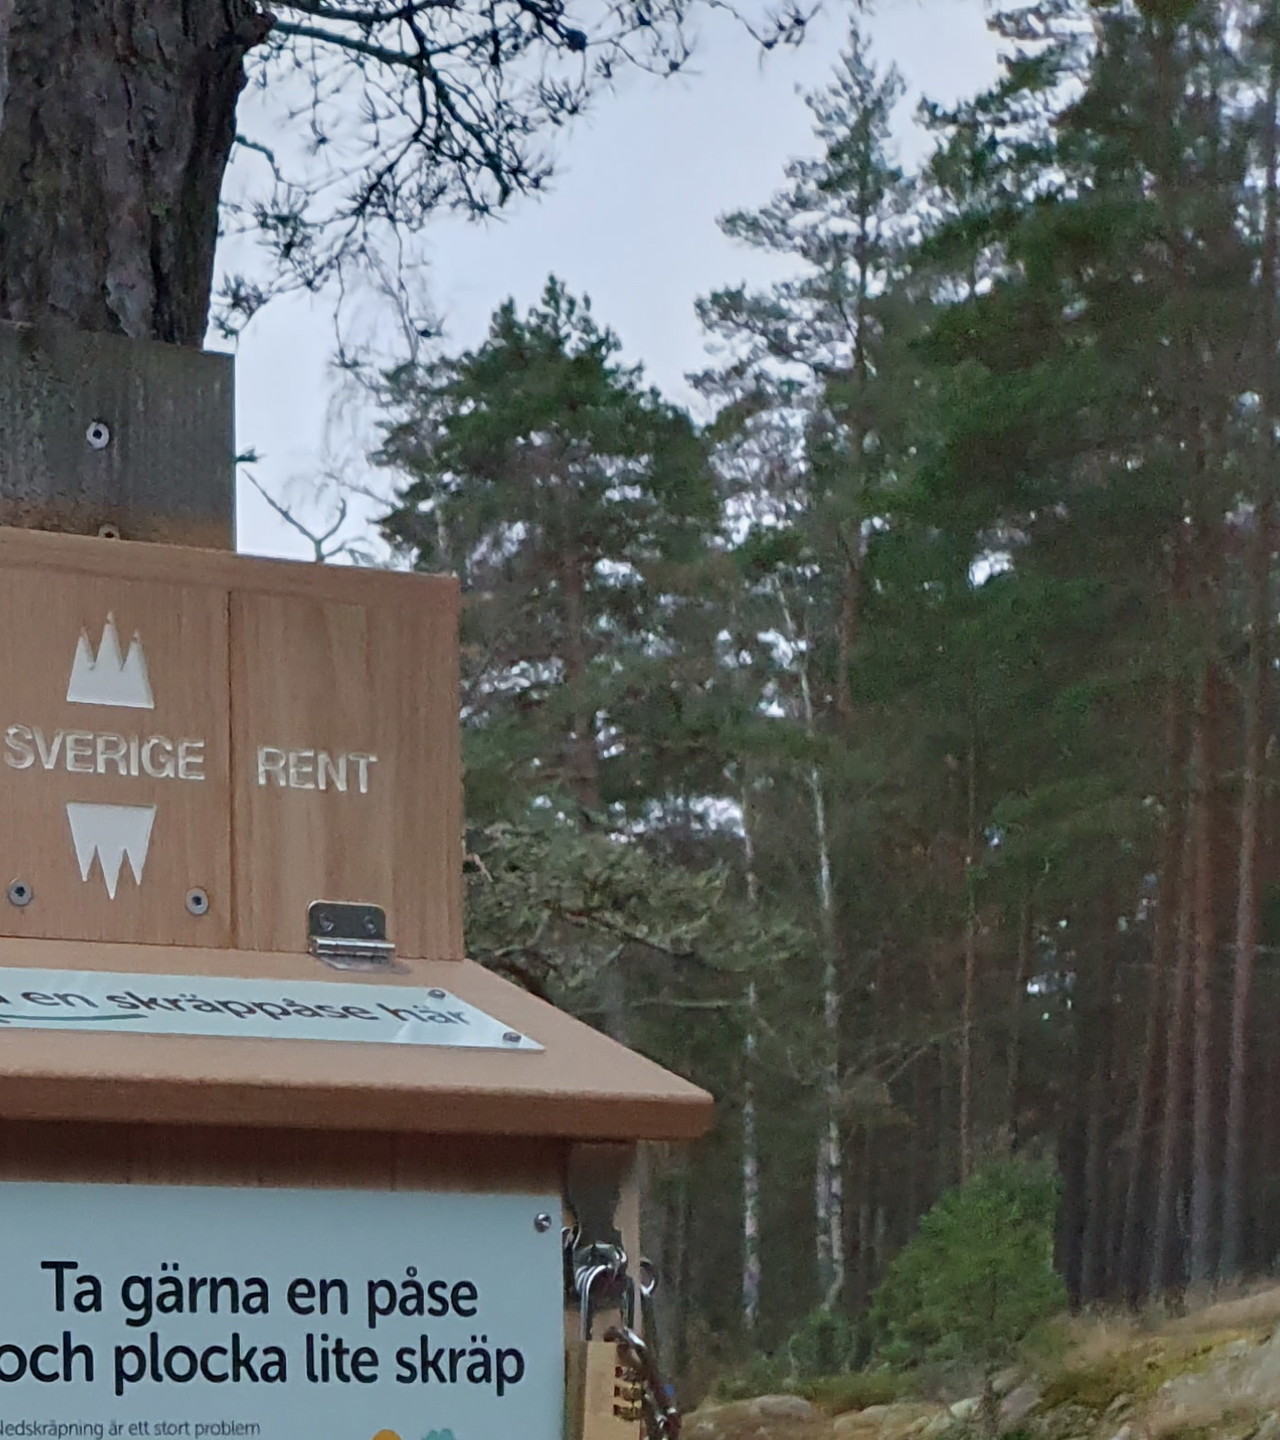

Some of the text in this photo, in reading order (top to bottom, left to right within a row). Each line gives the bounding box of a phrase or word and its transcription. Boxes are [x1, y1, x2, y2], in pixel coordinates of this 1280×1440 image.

[3, 722, 206, 781] SVERIGE
[256, 745, 379, 795] RENT
[19, 988, 98, 1010] en
[106, 990, 381, 1023] skräppåse
[382, 1001, 472, 1027] här
[40, 1260, 479, 1329] Ta gärna en påse
[114, 1331, 287, 1397] plocka
[306, 1333, 380, 1384] lite
[394, 1334, 526, 1397] skräp
[108, 1420, 124, 1436] är
[128, 1419, 150, 1436] ett
[153, 1419, 190, 1436] stort
[195, 1419, 260, 1440] problem
